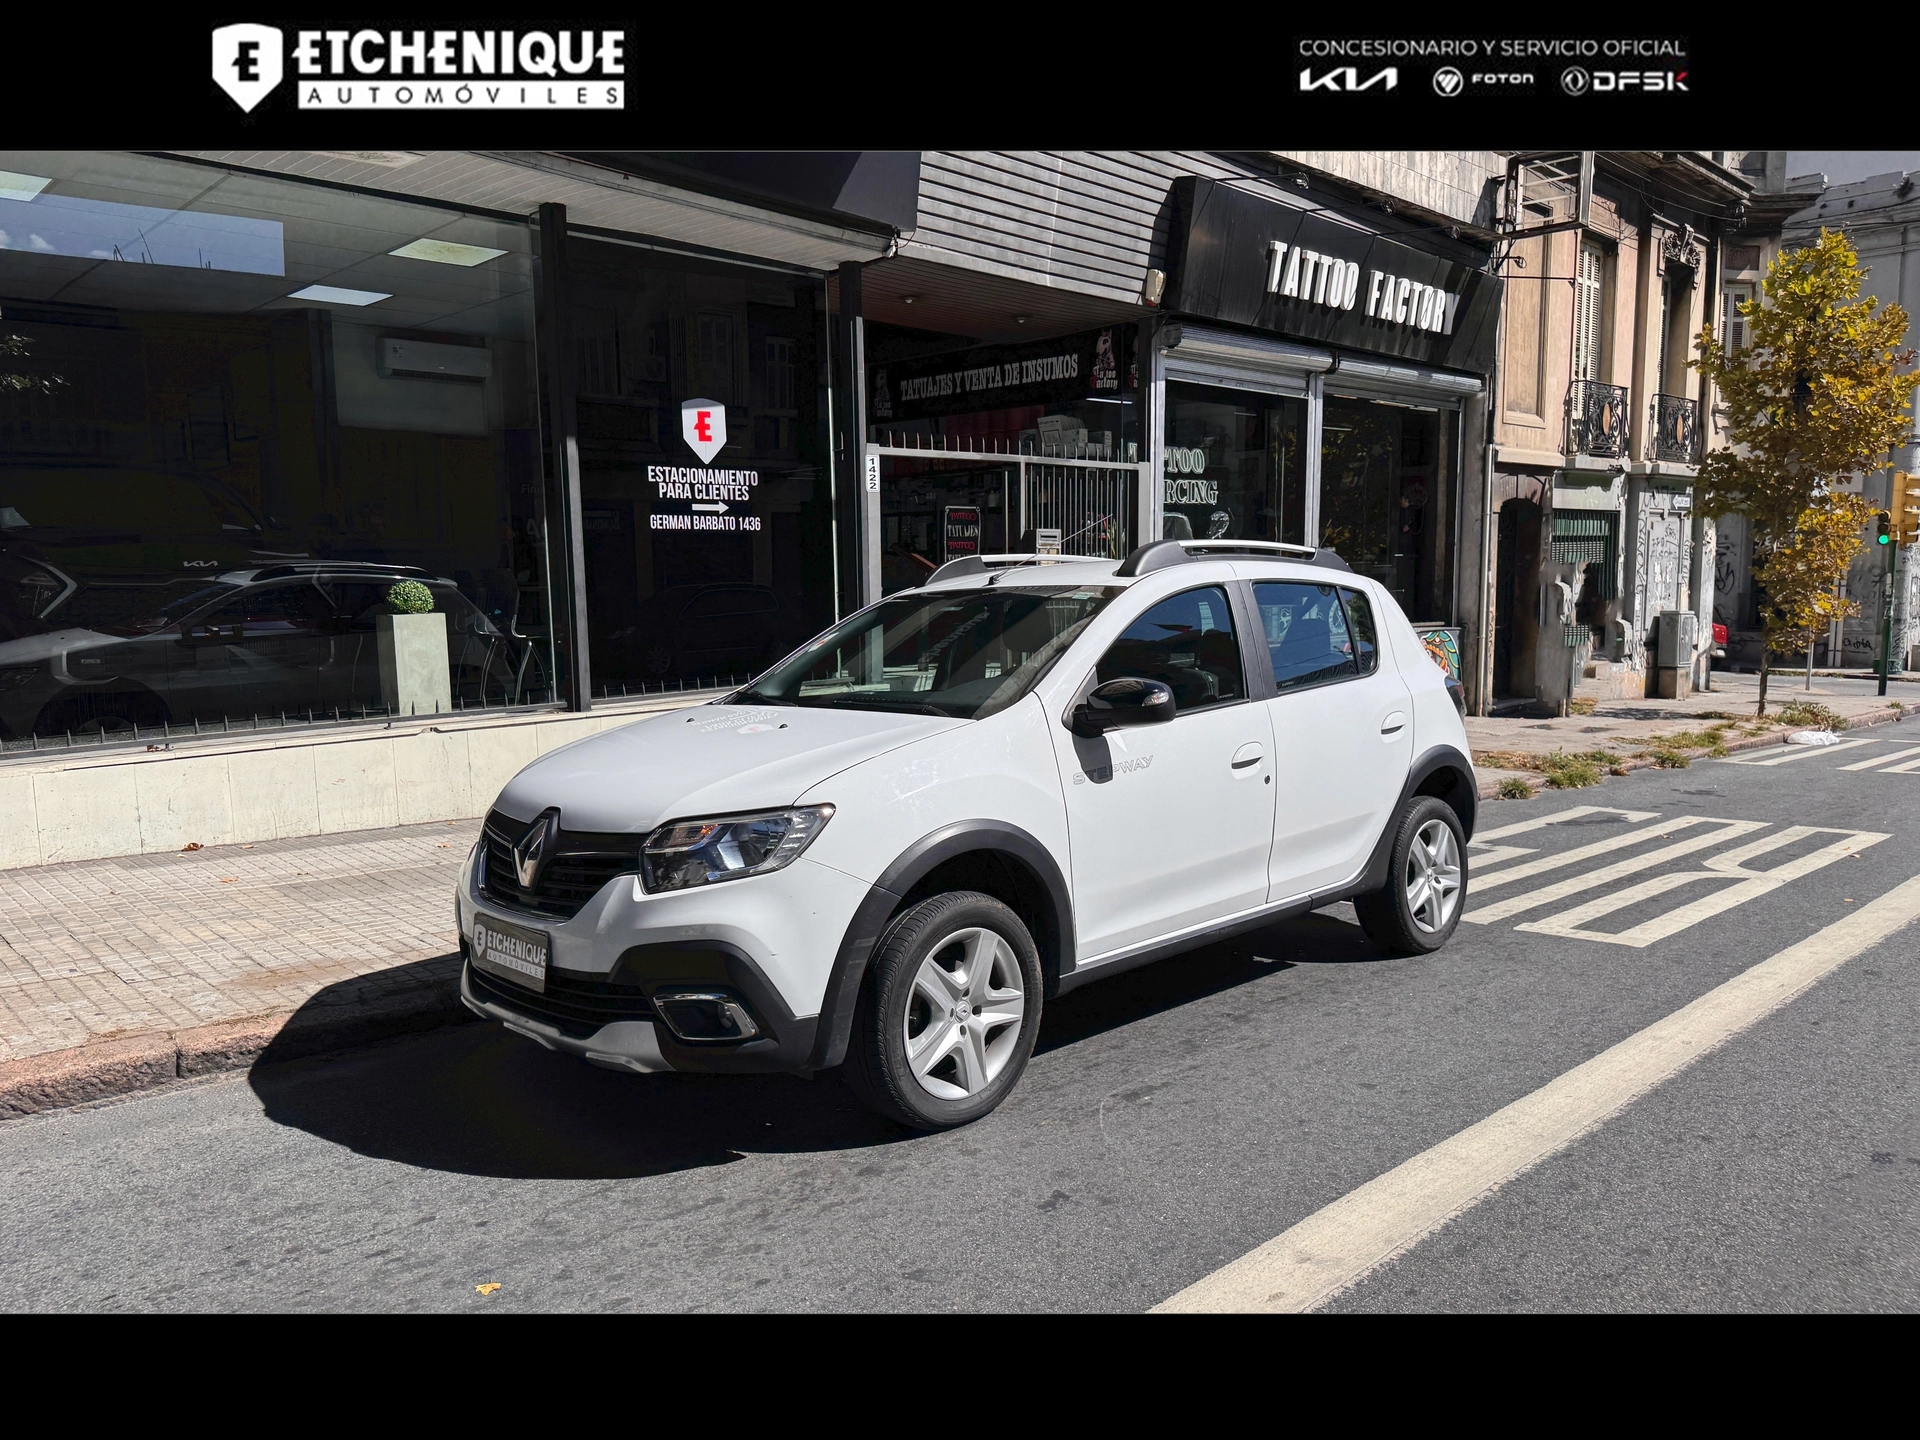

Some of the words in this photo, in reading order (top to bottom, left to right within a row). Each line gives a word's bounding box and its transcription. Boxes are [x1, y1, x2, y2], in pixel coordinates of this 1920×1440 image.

[1266, 240, 1360, 311] TATTOO
[1365, 270, 1461, 335] FACTORY
[900, 372, 953, 401] TATUAJES
[954, 371, 963, 393] Y
[963, 365, 1003, 391] VENTA
[1004, 362, 1020, 386] DE
[1022, 353, 1078, 384] INSUMOS
[868, 457, 878, 490] 1422
[1163, 446, 1205, 474] TOO
[647, 465, 759, 487] ESTACIONAMIENTO
[658, 482, 692, 499] PARA
[694, 483, 750, 501] CLIENTES
[650, 514, 691, 530] GERMAN
[693, 515, 736, 531] BARBATO
[738, 516, 761, 531] 1436
[1072, 755, 1154, 785] STEPWAY
[487, 930, 547, 967] ETCHENIQUE
[487, 951, 545, 979] AUTOMÓVILES
